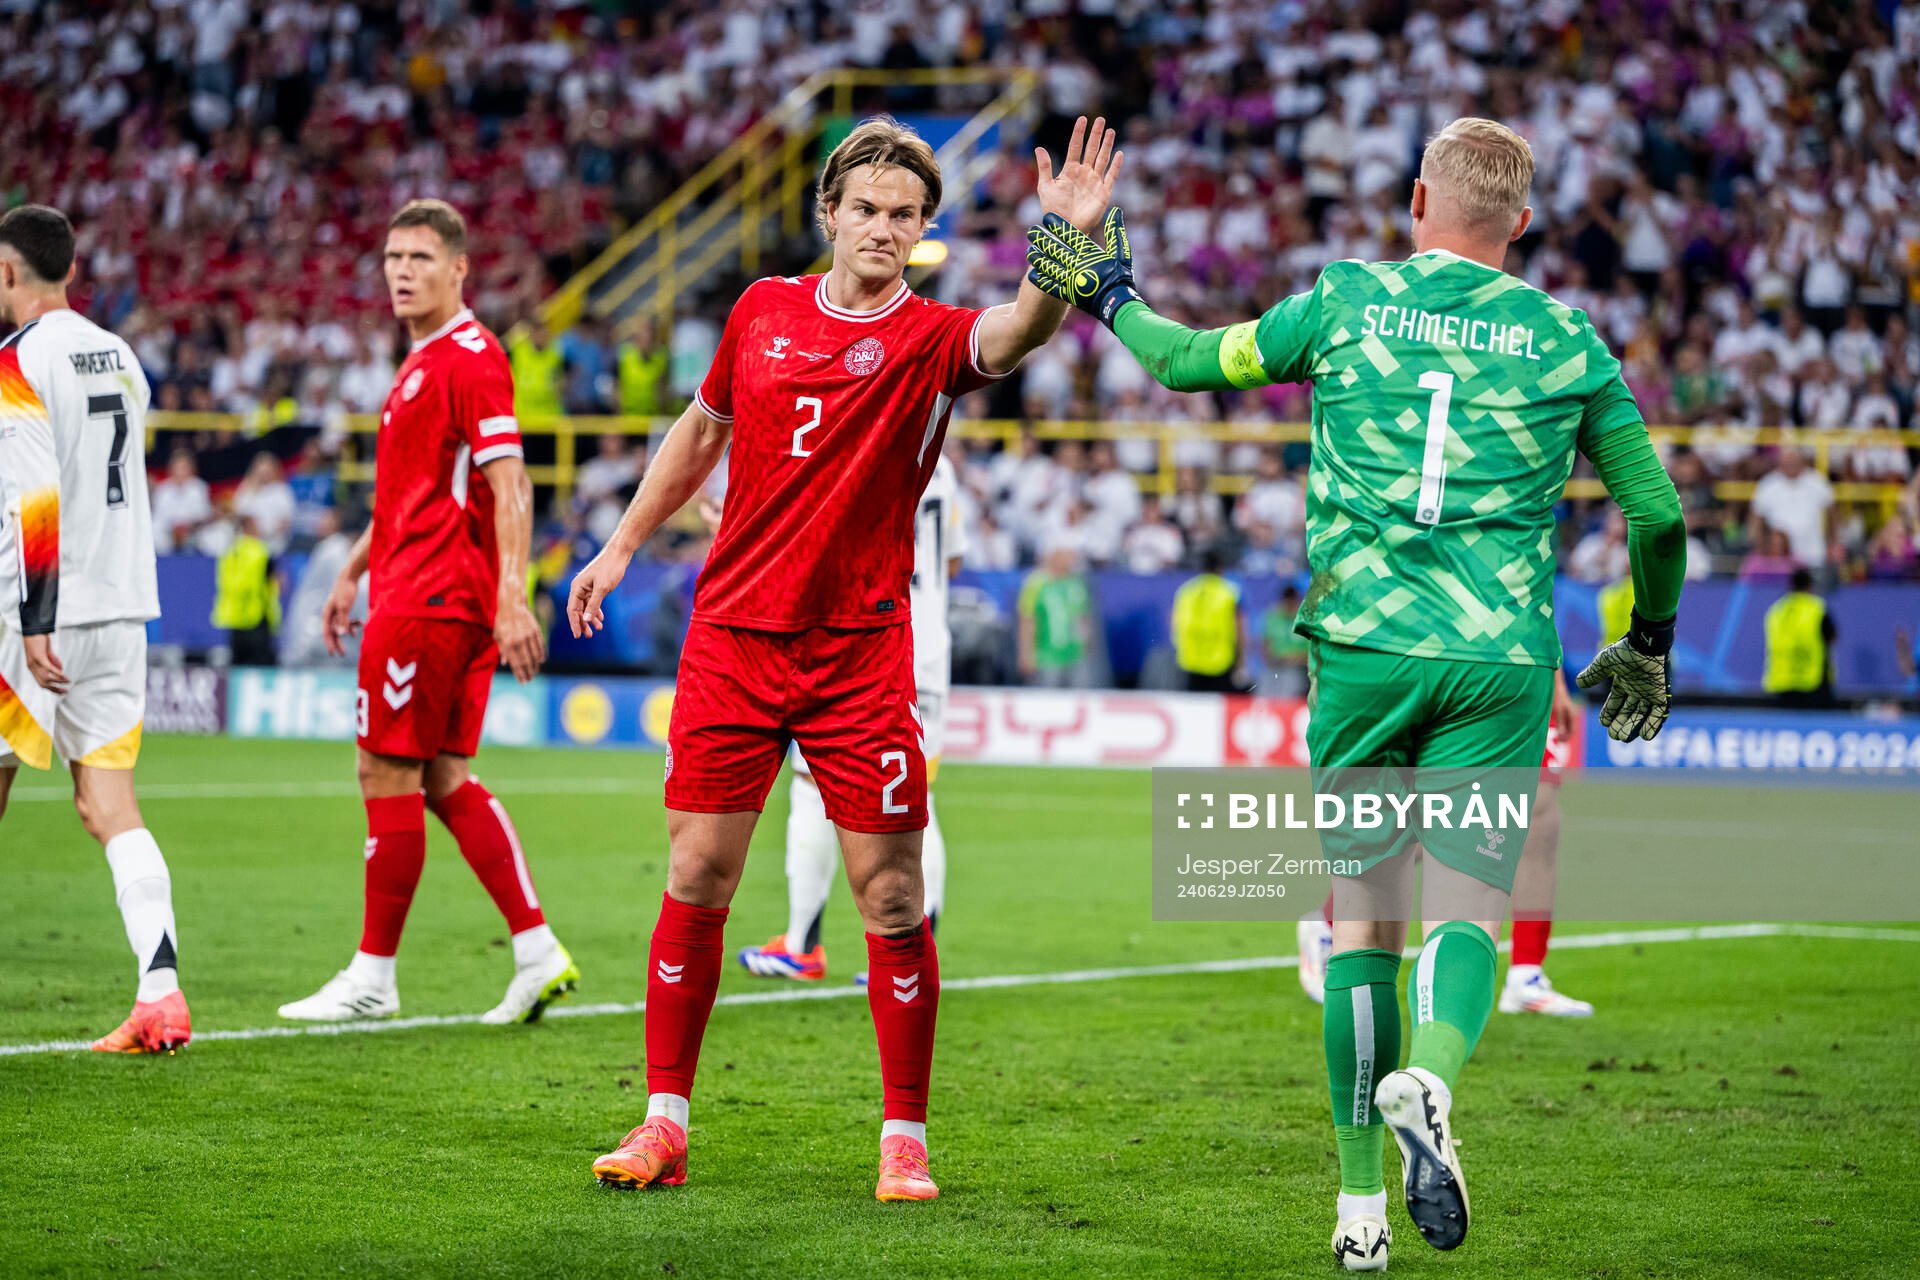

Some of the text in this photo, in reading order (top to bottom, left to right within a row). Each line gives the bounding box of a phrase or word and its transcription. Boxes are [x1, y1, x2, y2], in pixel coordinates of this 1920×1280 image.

[68, 349, 125, 376] HAVERTZ
[1361, 304, 1541, 360] SCHMEICHEL
[88, 393, 129, 510] 7
[791, 395, 822, 458] 2
[1415, 370, 1454, 525] 1
[881, 750, 909, 814] 2
